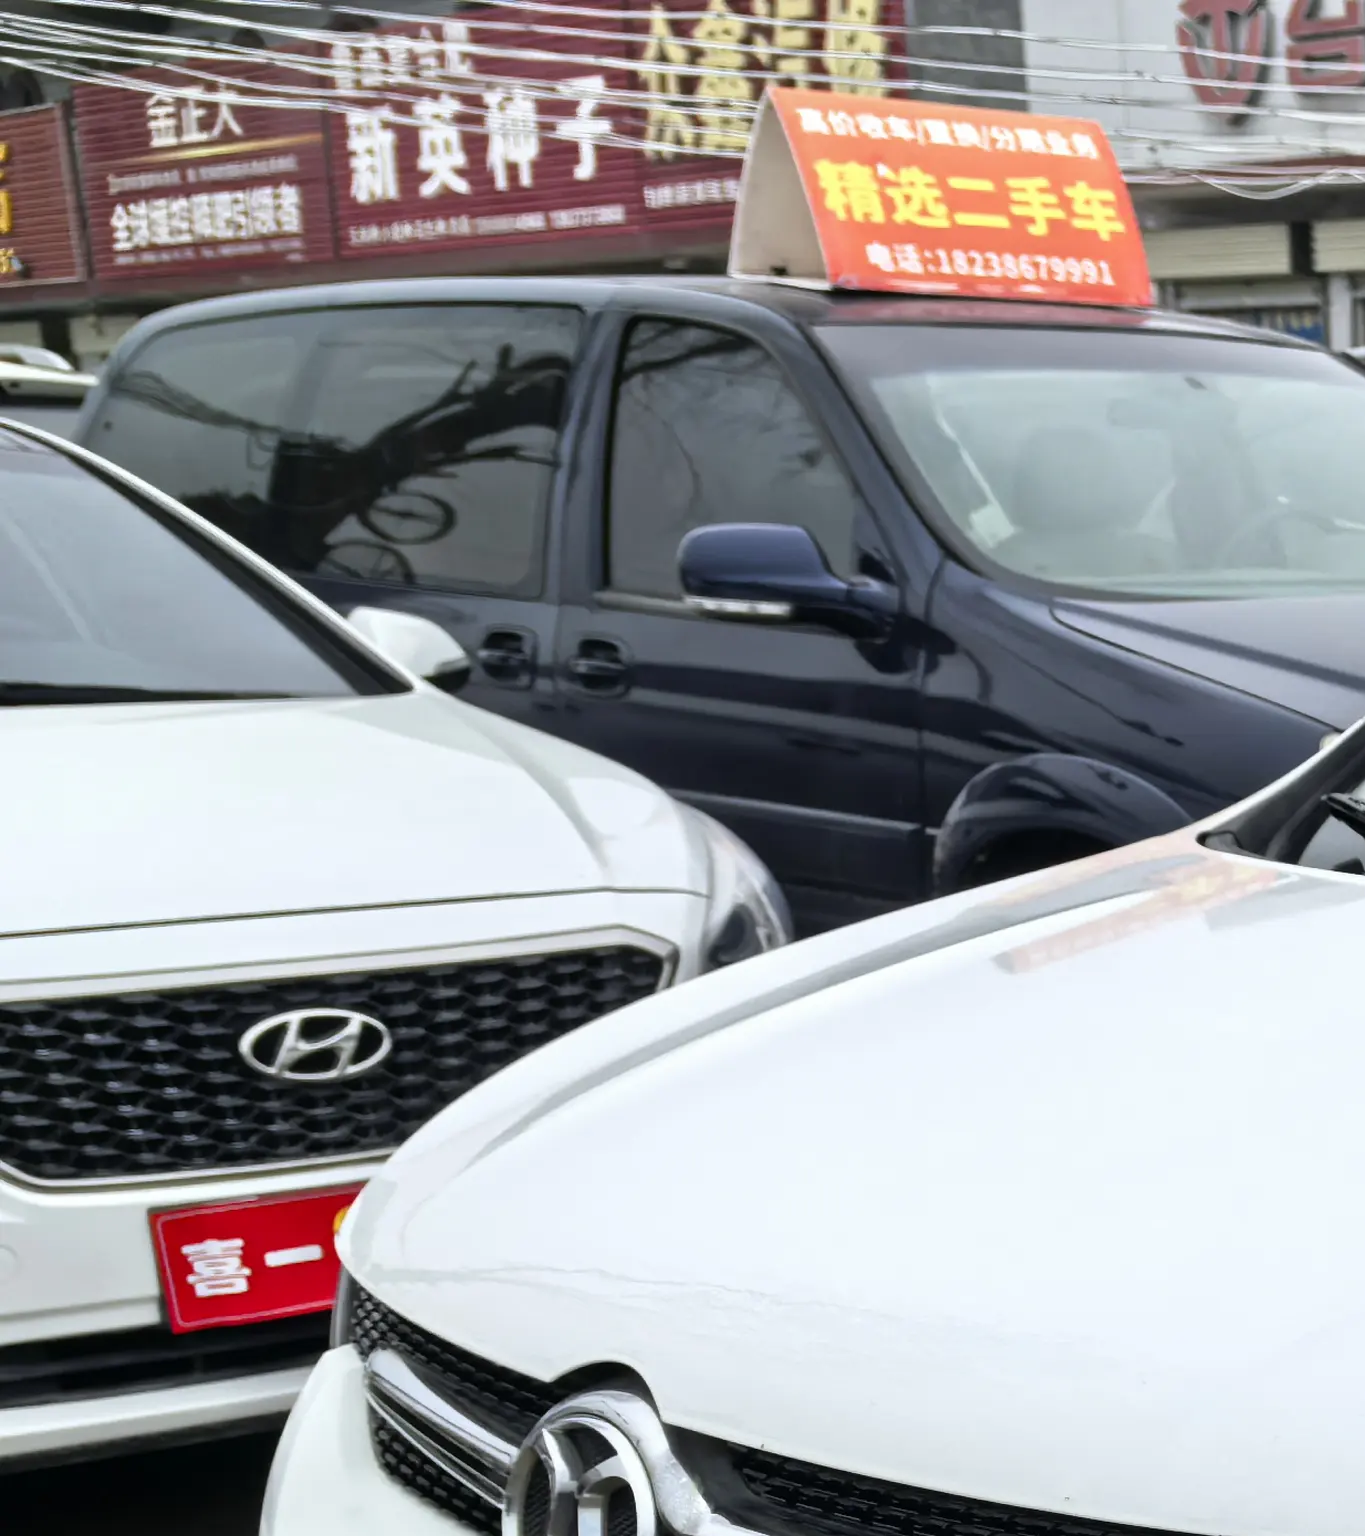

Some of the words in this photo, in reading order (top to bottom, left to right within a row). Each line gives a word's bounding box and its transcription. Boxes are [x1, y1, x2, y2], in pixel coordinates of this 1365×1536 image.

[813, 159, 1126, 242] 精选二手车
[181, 1222, 342, 1297] 喜一
